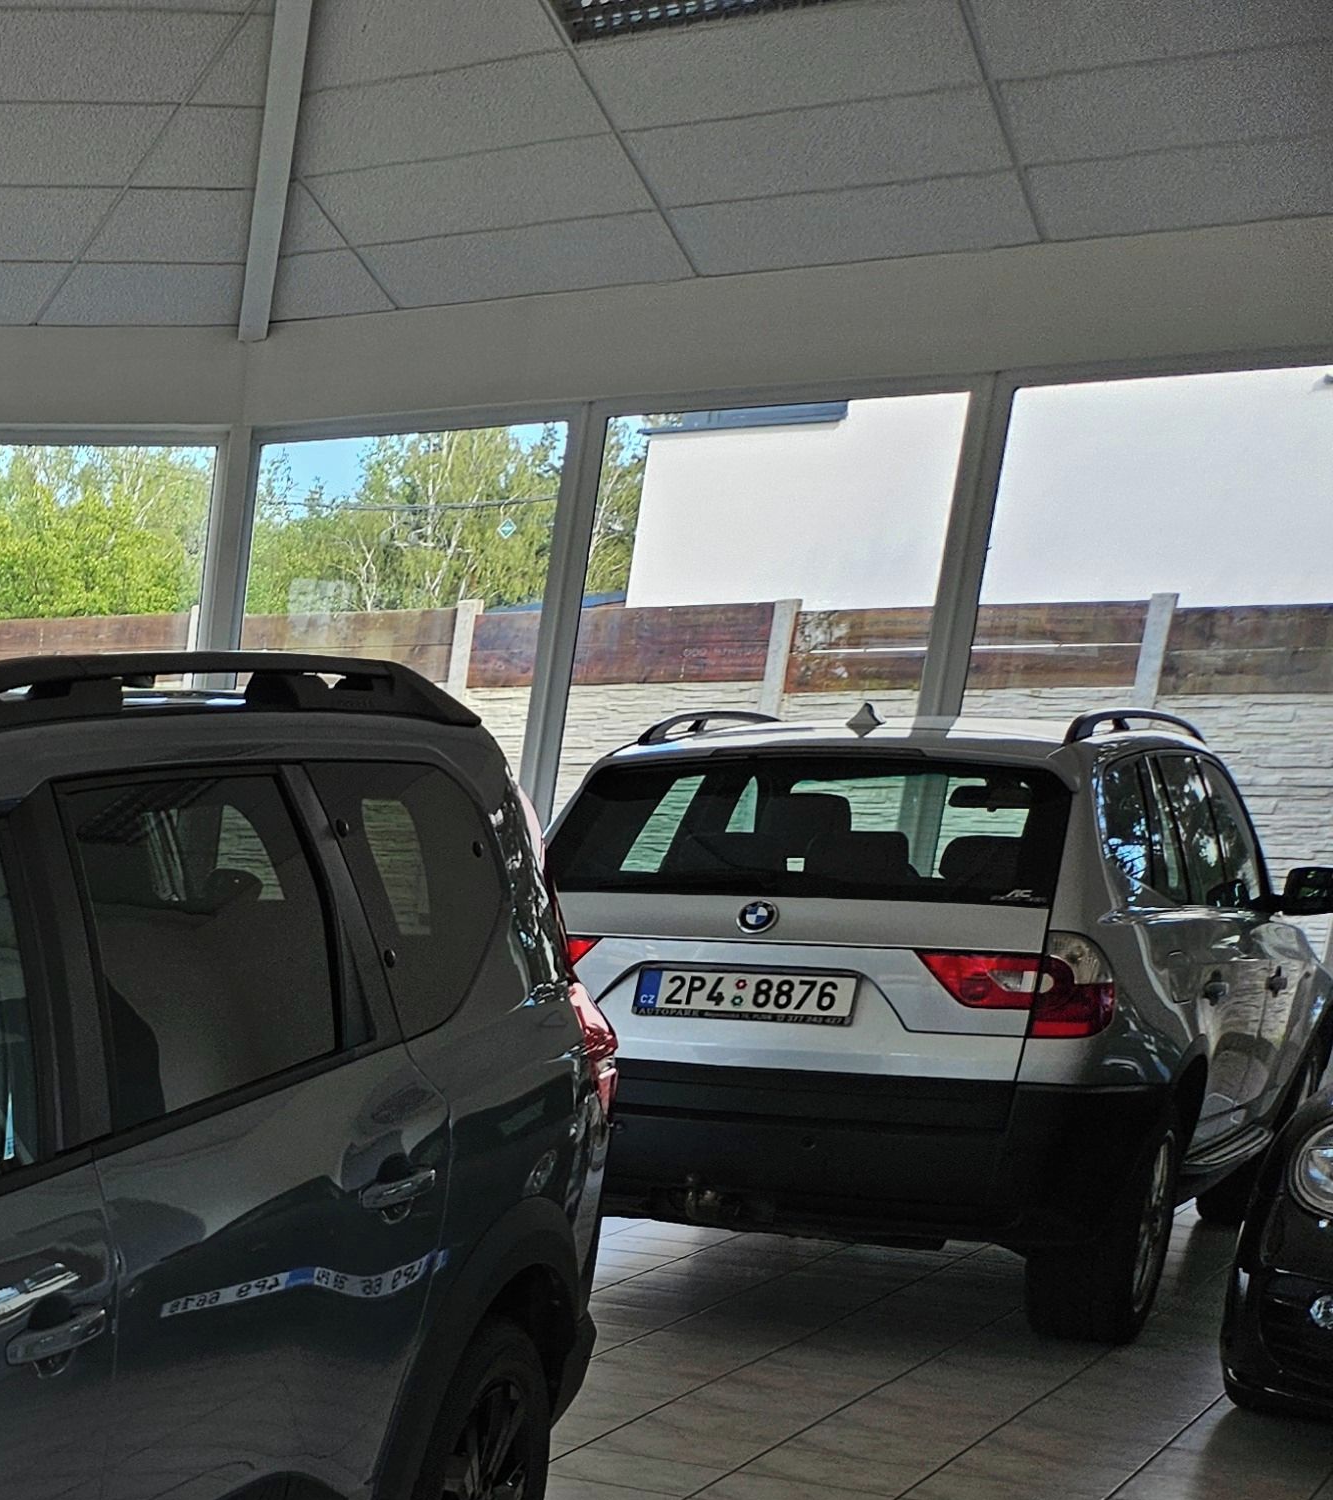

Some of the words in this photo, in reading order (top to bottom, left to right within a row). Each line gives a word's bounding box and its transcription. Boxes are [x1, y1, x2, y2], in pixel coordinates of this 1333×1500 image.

[664, 976, 725, 1006] 2P4
[751, 978, 838, 1011] 8876
[640, 994, 656, 1005] CZ
[638, 1007, 699, 1018] AUTOPARK
